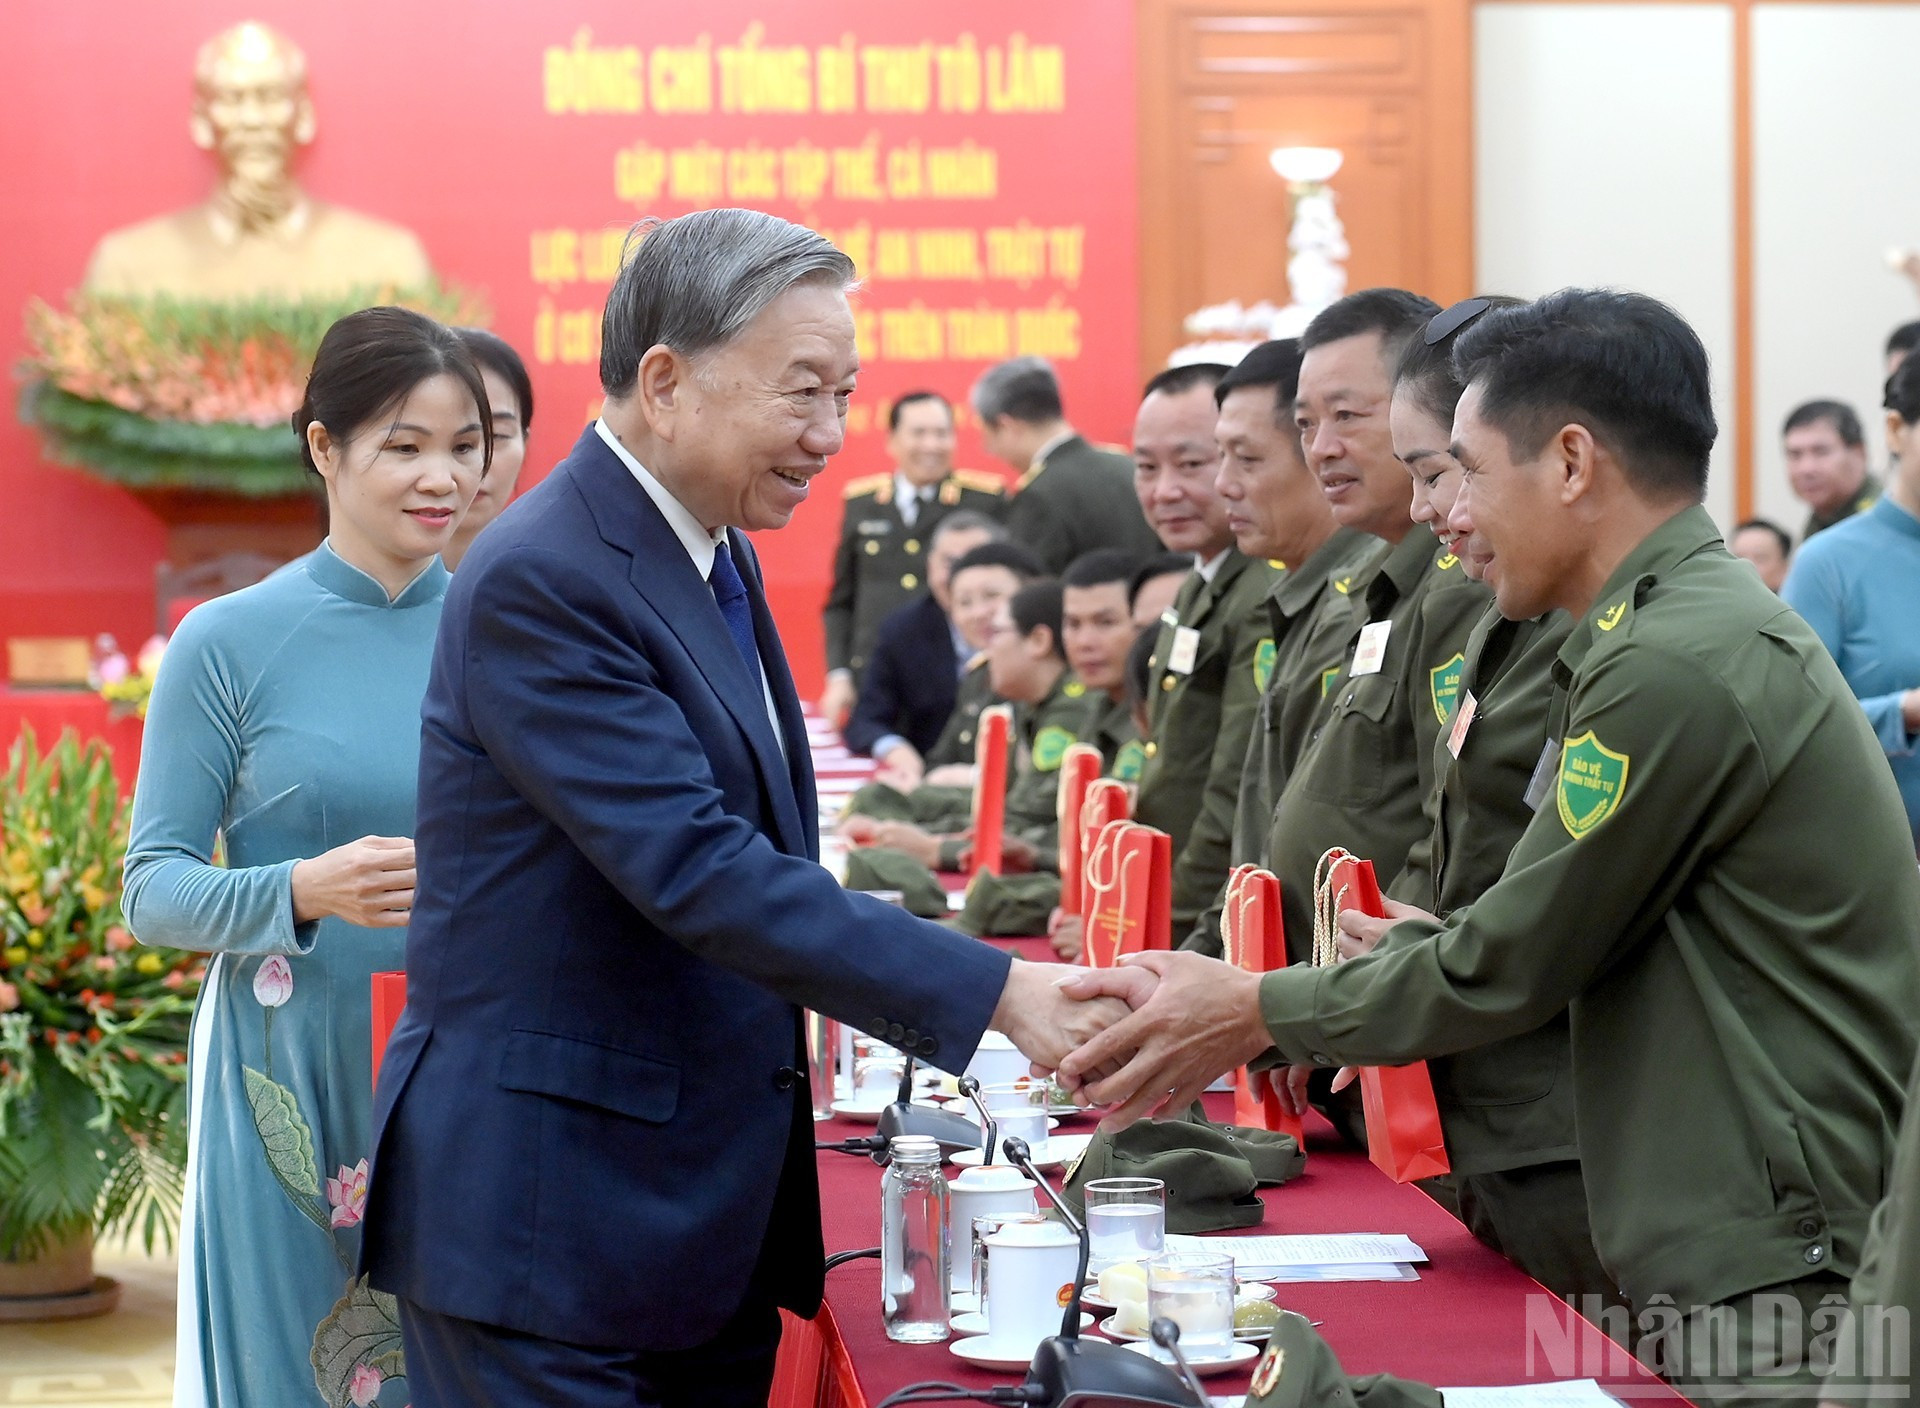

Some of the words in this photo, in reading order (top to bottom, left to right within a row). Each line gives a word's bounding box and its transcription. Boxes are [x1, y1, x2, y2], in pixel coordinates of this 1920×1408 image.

[937, 32, 981, 113] TÔ
[987, 32, 1064, 113] LÂM
[926, 138, 997, 199] NHÂN
